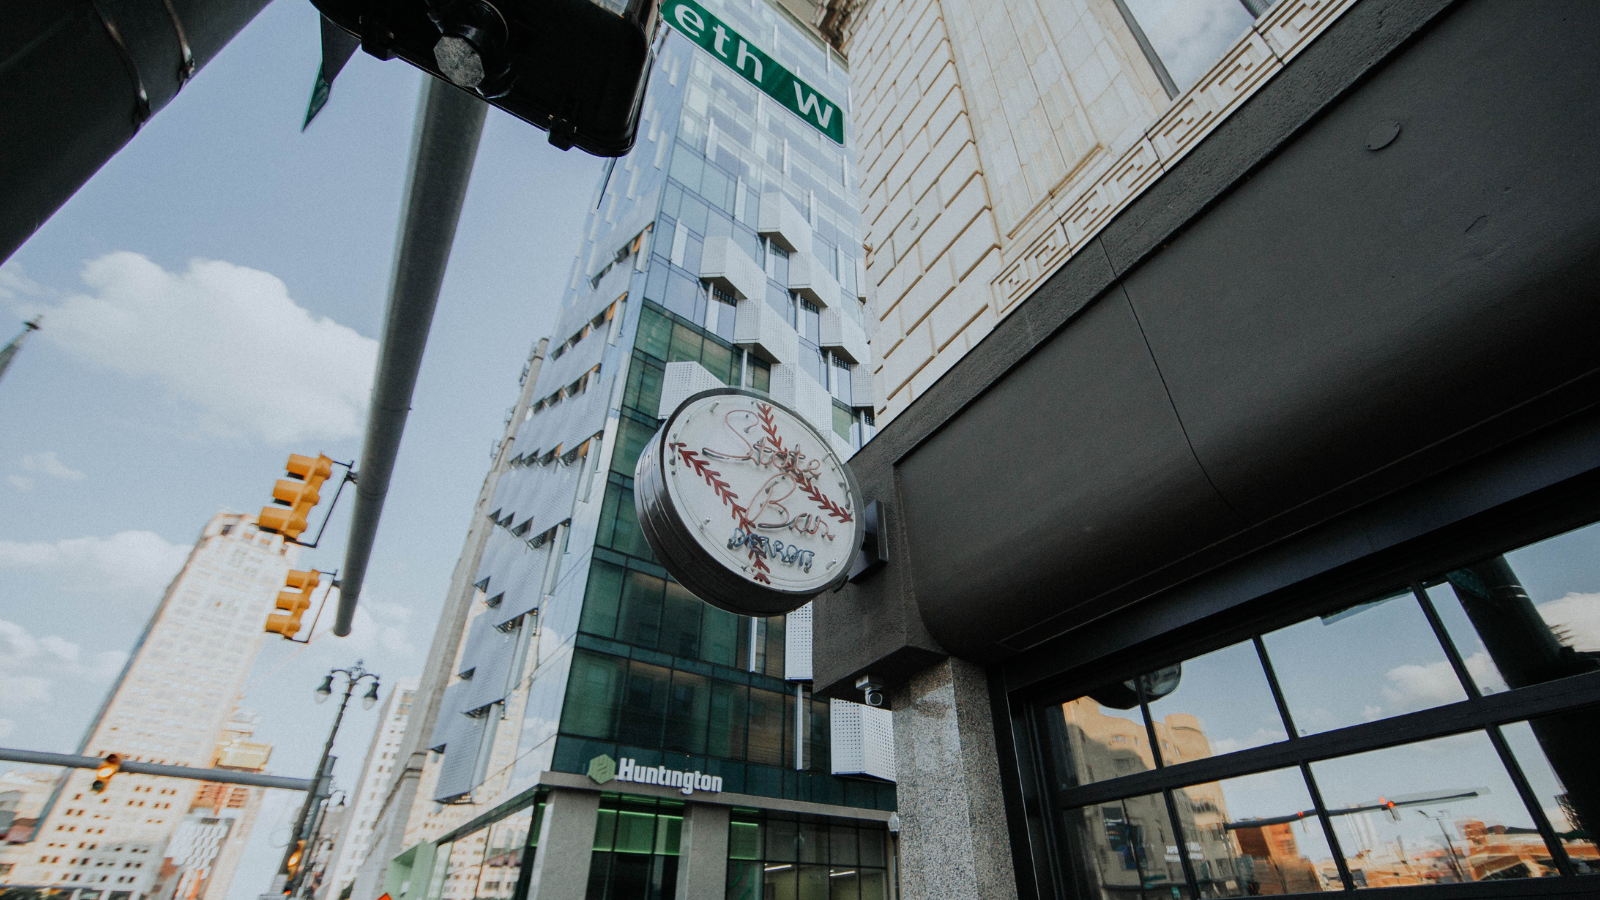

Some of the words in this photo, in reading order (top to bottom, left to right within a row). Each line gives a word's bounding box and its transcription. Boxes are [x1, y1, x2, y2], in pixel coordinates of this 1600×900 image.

[702, 409, 821, 478] State
[744, 472, 836, 540] Bar
[730, 527, 815, 572] DETROIT
[617, 757, 723, 795] Huntington
